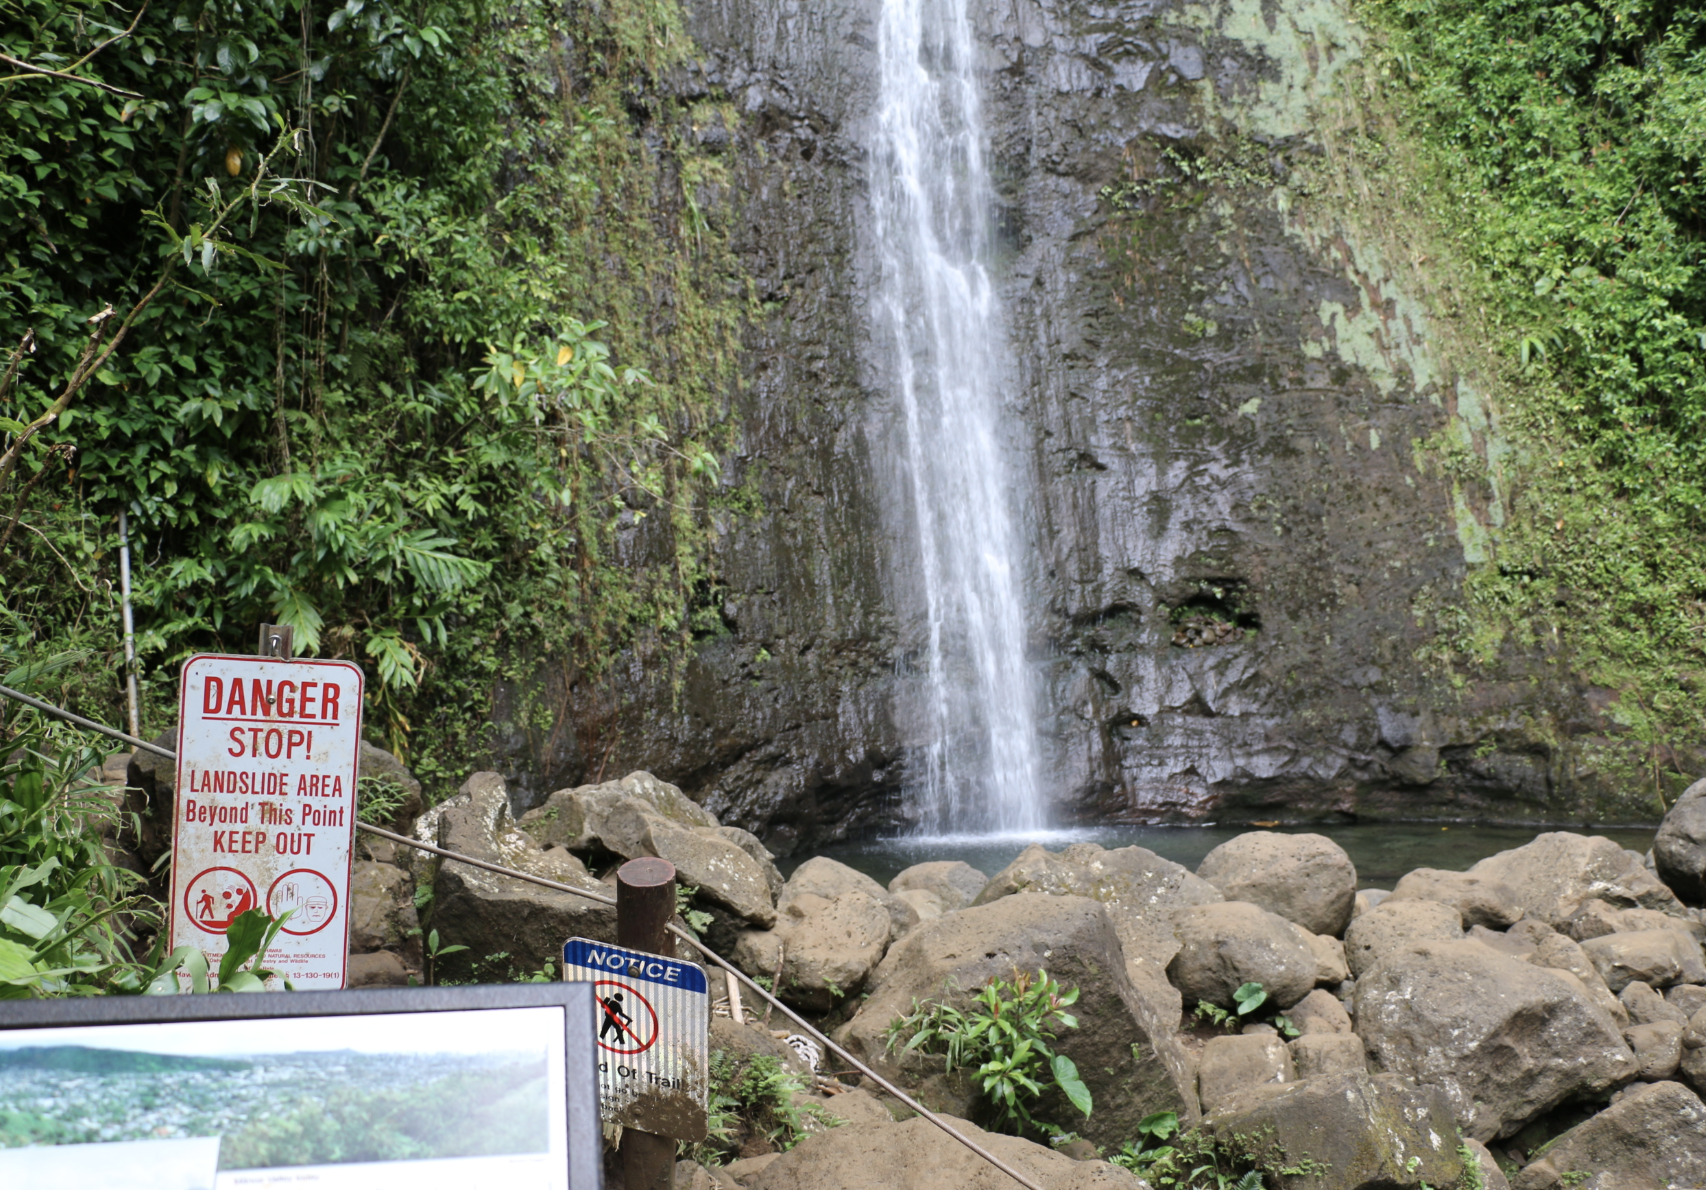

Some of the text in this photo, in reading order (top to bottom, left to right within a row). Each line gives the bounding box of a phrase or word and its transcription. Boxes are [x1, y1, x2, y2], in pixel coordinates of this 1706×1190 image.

[203, 676, 341, 720] DANGER
[228, 727, 313, 760] STOP!
[190, 769, 343, 797] LANDSLIDE AREA
[186, 799, 344, 827] Beyond This Point
[213, 830, 316, 855] KEEP OUT
[587, 949, 681, 982] NOTICE
[617, 1065, 637, 1080] Of
[646, 1071, 681, 1091] Trail
